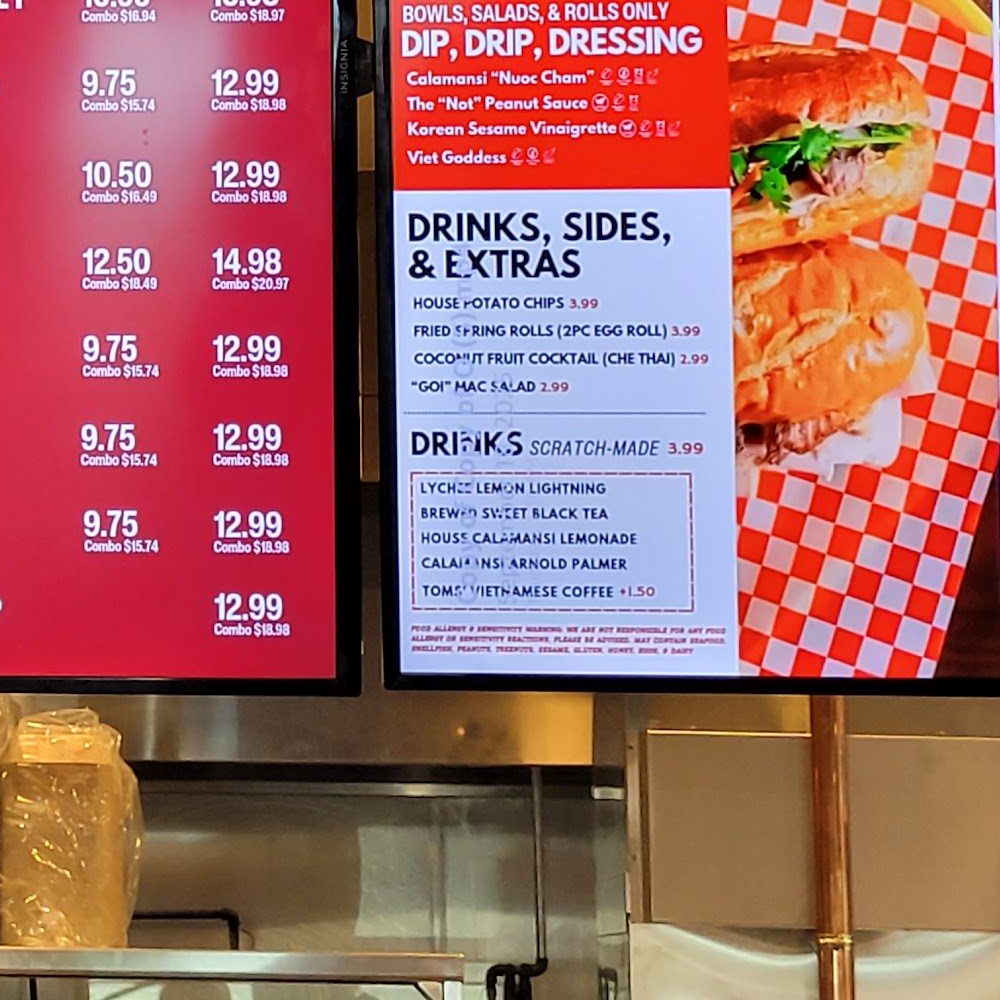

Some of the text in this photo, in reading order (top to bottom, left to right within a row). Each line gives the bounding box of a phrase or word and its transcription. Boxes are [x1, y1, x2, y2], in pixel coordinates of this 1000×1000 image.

[402, 2, 669, 25] BOWLS, SALADS, & ROLLS ONLY
[401, 26, 703, 63] DIP, DRIP, DRESSING
[340, 39, 349, 94] INSIGNIA
[407, 70, 595, 87] Calamansi “Nuoc Cham”
[407, 121, 617, 139] Korean Sesame Vinaigrette
[407, 150, 507, 165] Viet Goddess
[408, 211, 671, 247] DRINKS, SIDES,
[408, 249, 581, 278] & EXTRAS
[529, 439, 703, 457] SCRATCH-MADE 3.99
